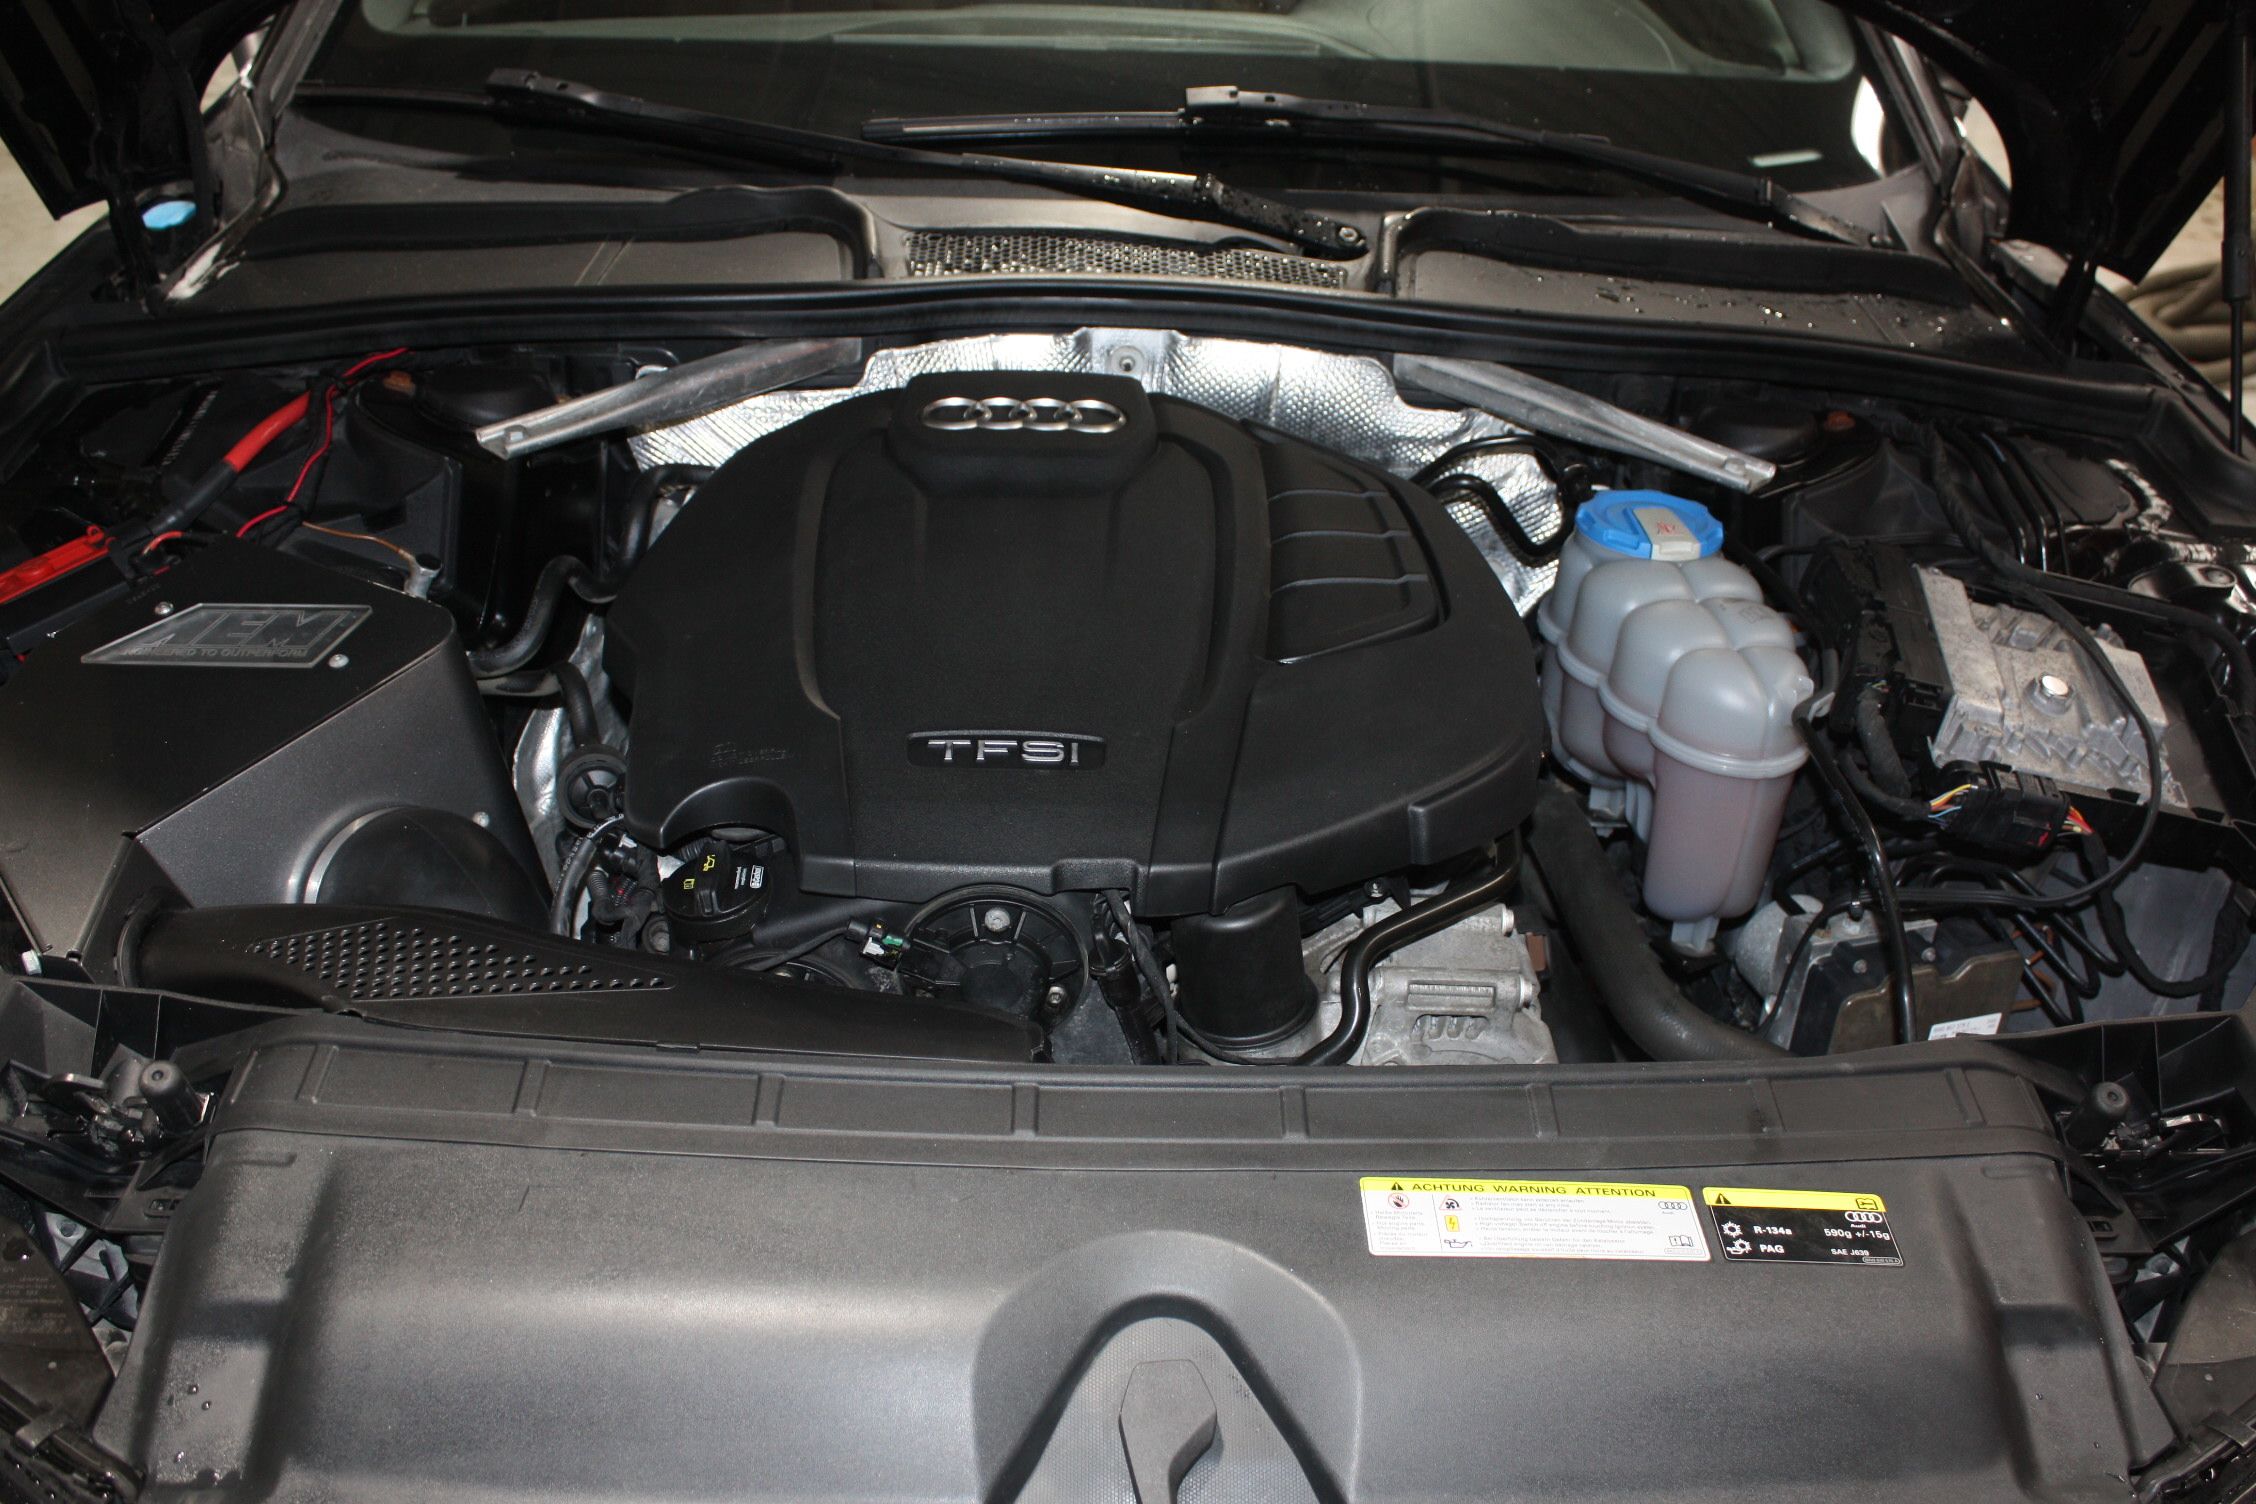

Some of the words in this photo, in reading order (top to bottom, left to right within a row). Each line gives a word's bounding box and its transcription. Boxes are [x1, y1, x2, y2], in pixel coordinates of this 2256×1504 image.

[136, 609, 348, 649] AEM
[200, 647, 218, 657] TO
[927, 739, 1078, 765] TFSI
[1412, 1183, 1485, 1193] ACHTUNG
[1493, 1185, 1567, 1195] WARNING
[1576, 1187, 1656, 1197] ATTENTION
[1753, 1225, 1793, 1236] R-134a
[1824, 1228, 1852, 1240] 590g
[1855, 1229, 1891, 1241] +/-15g
[1759, 1244, 1785, 1254] PAG
[1830, 1248, 1848, 1256] SAE
[1850, 1249, 1870, 1257] J639
